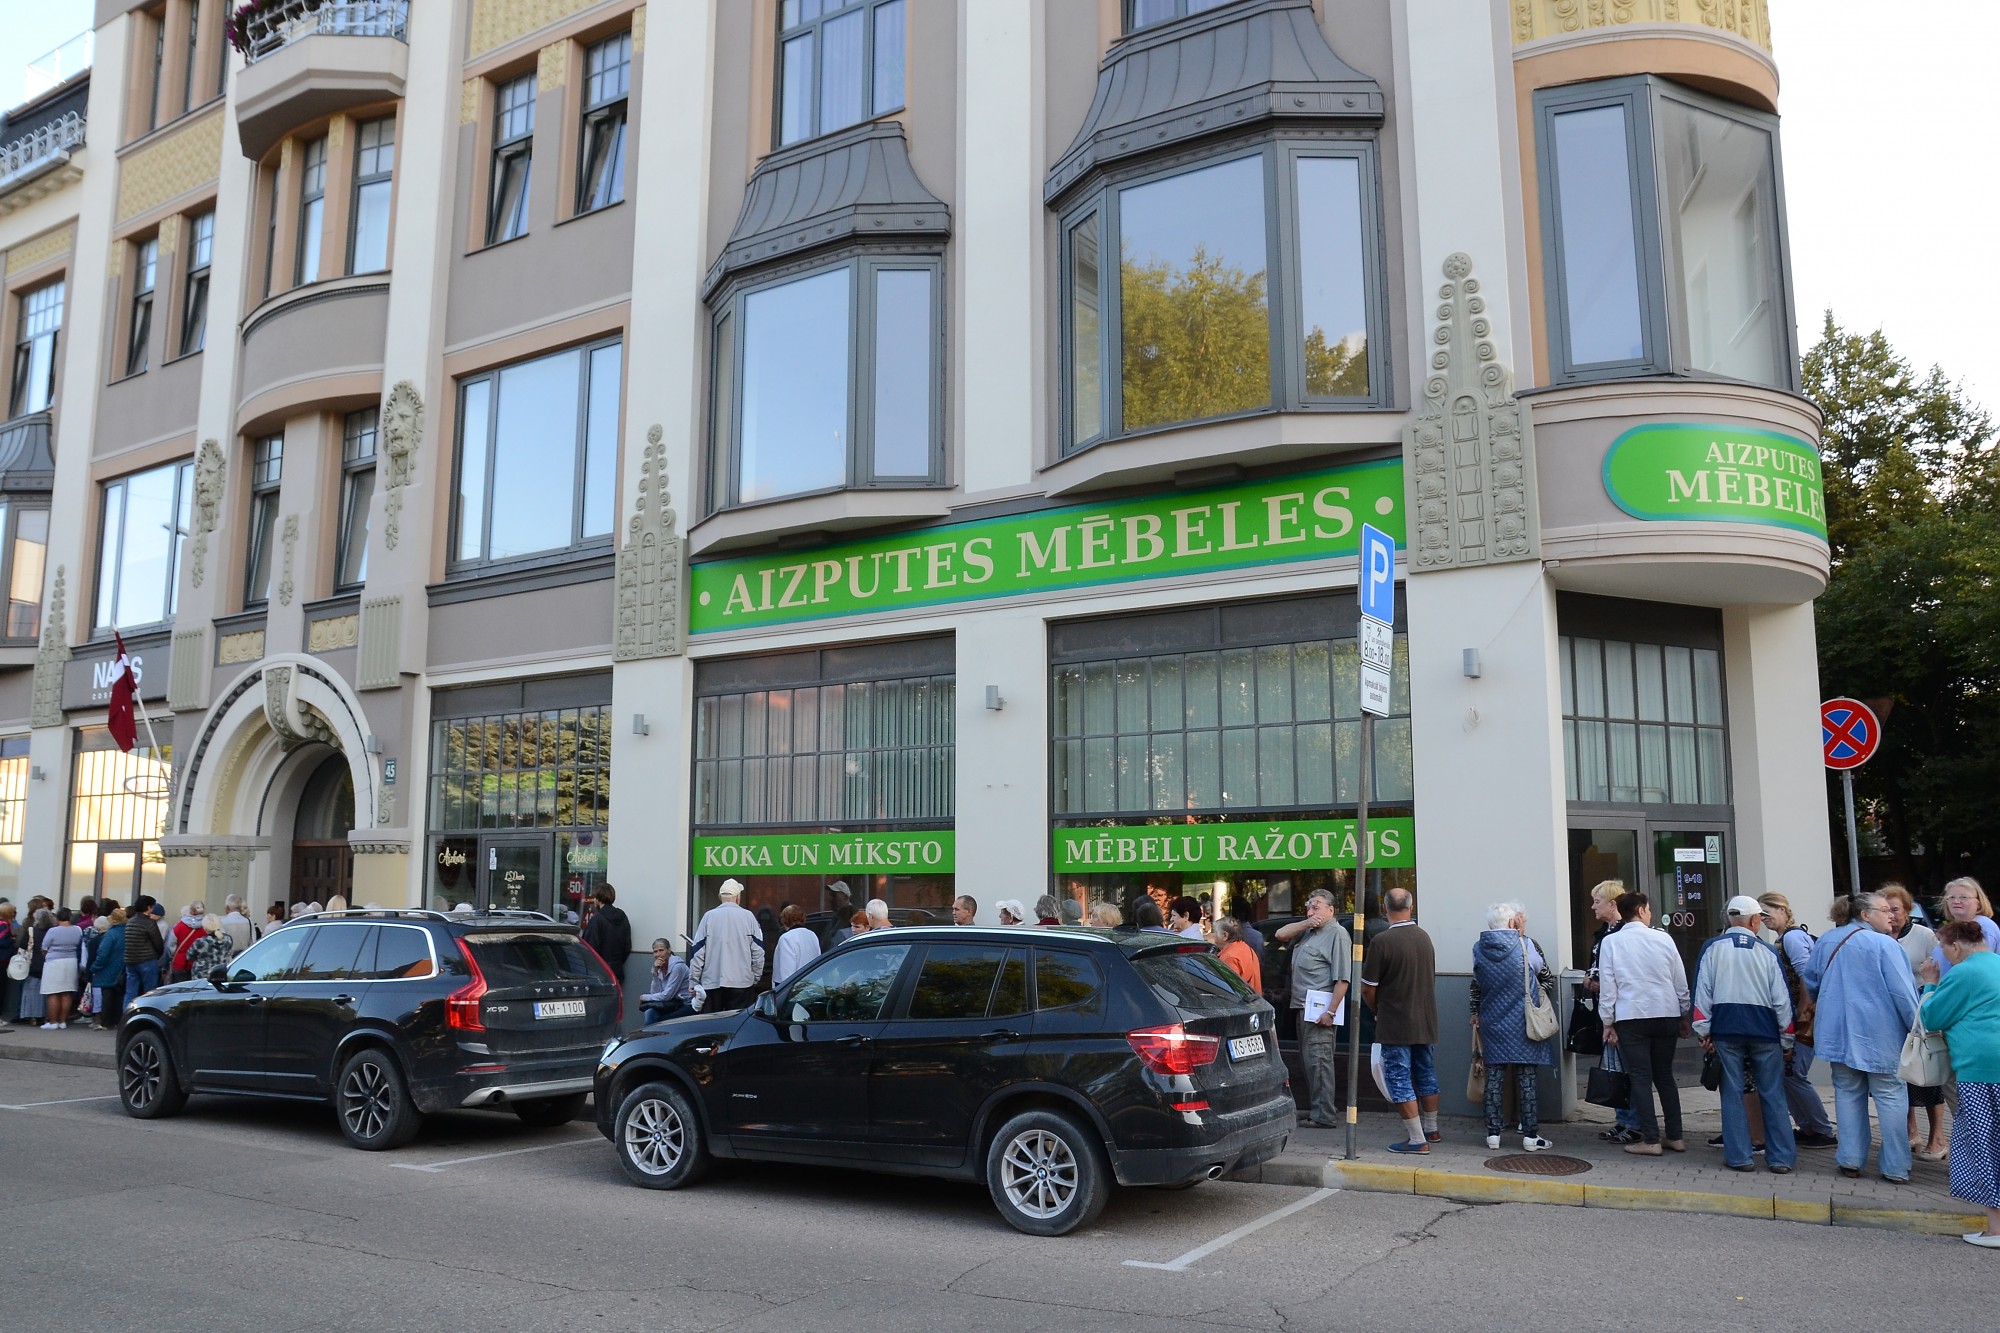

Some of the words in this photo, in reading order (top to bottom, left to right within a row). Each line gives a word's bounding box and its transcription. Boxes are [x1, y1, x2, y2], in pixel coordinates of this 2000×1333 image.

[1705, 442, 1815, 482] AIZPUTES
[722, 537, 994, 615] AIZPUTES
[1015, 486, 1354, 578] MĒBELES
[1369, 538, 1389, 608] P
[93, 656, 143, 689] NAS
[385, 765, 396, 778] 45
[703, 845, 773, 867] KOKA
[781, 844, 820, 866] UN
[828, 838, 943, 866] MĪKSTO
[1065, 833, 1205, 869] MĒBEĻU
[1217, 825, 1402, 864] RAŽOTĀJS
[486, 1005, 509, 1013] XC90
[540, 1002, 584, 1016] KM-1100
